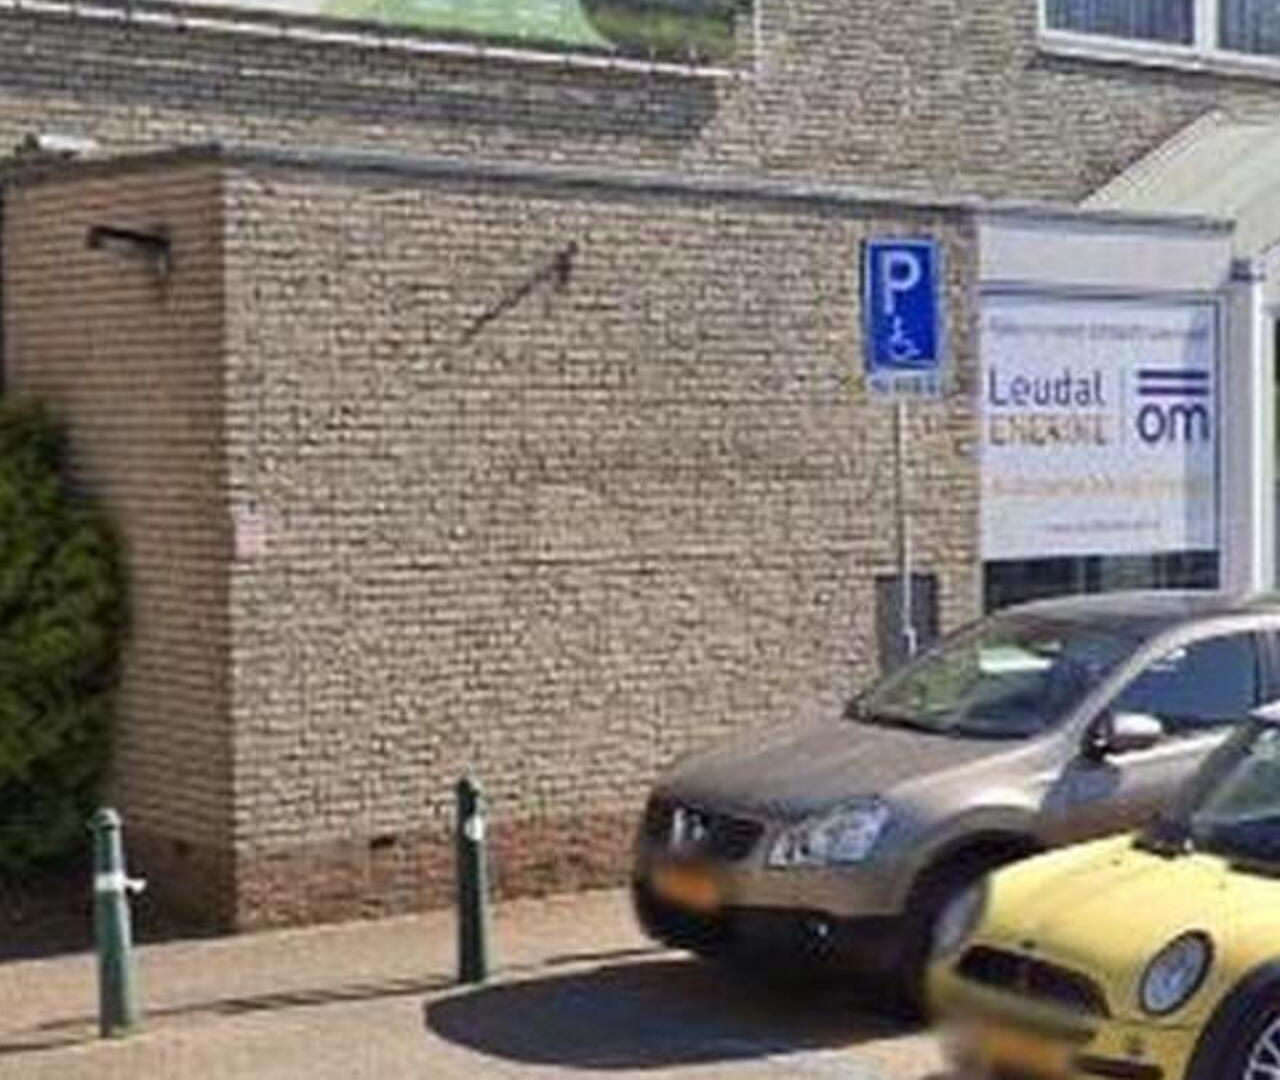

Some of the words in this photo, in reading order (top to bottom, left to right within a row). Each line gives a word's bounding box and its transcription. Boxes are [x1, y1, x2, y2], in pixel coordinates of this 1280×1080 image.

[882, 249, 922, 314] P
[988, 366, 1105, 407] Leudal
[1136, 401, 1211, 445] om
